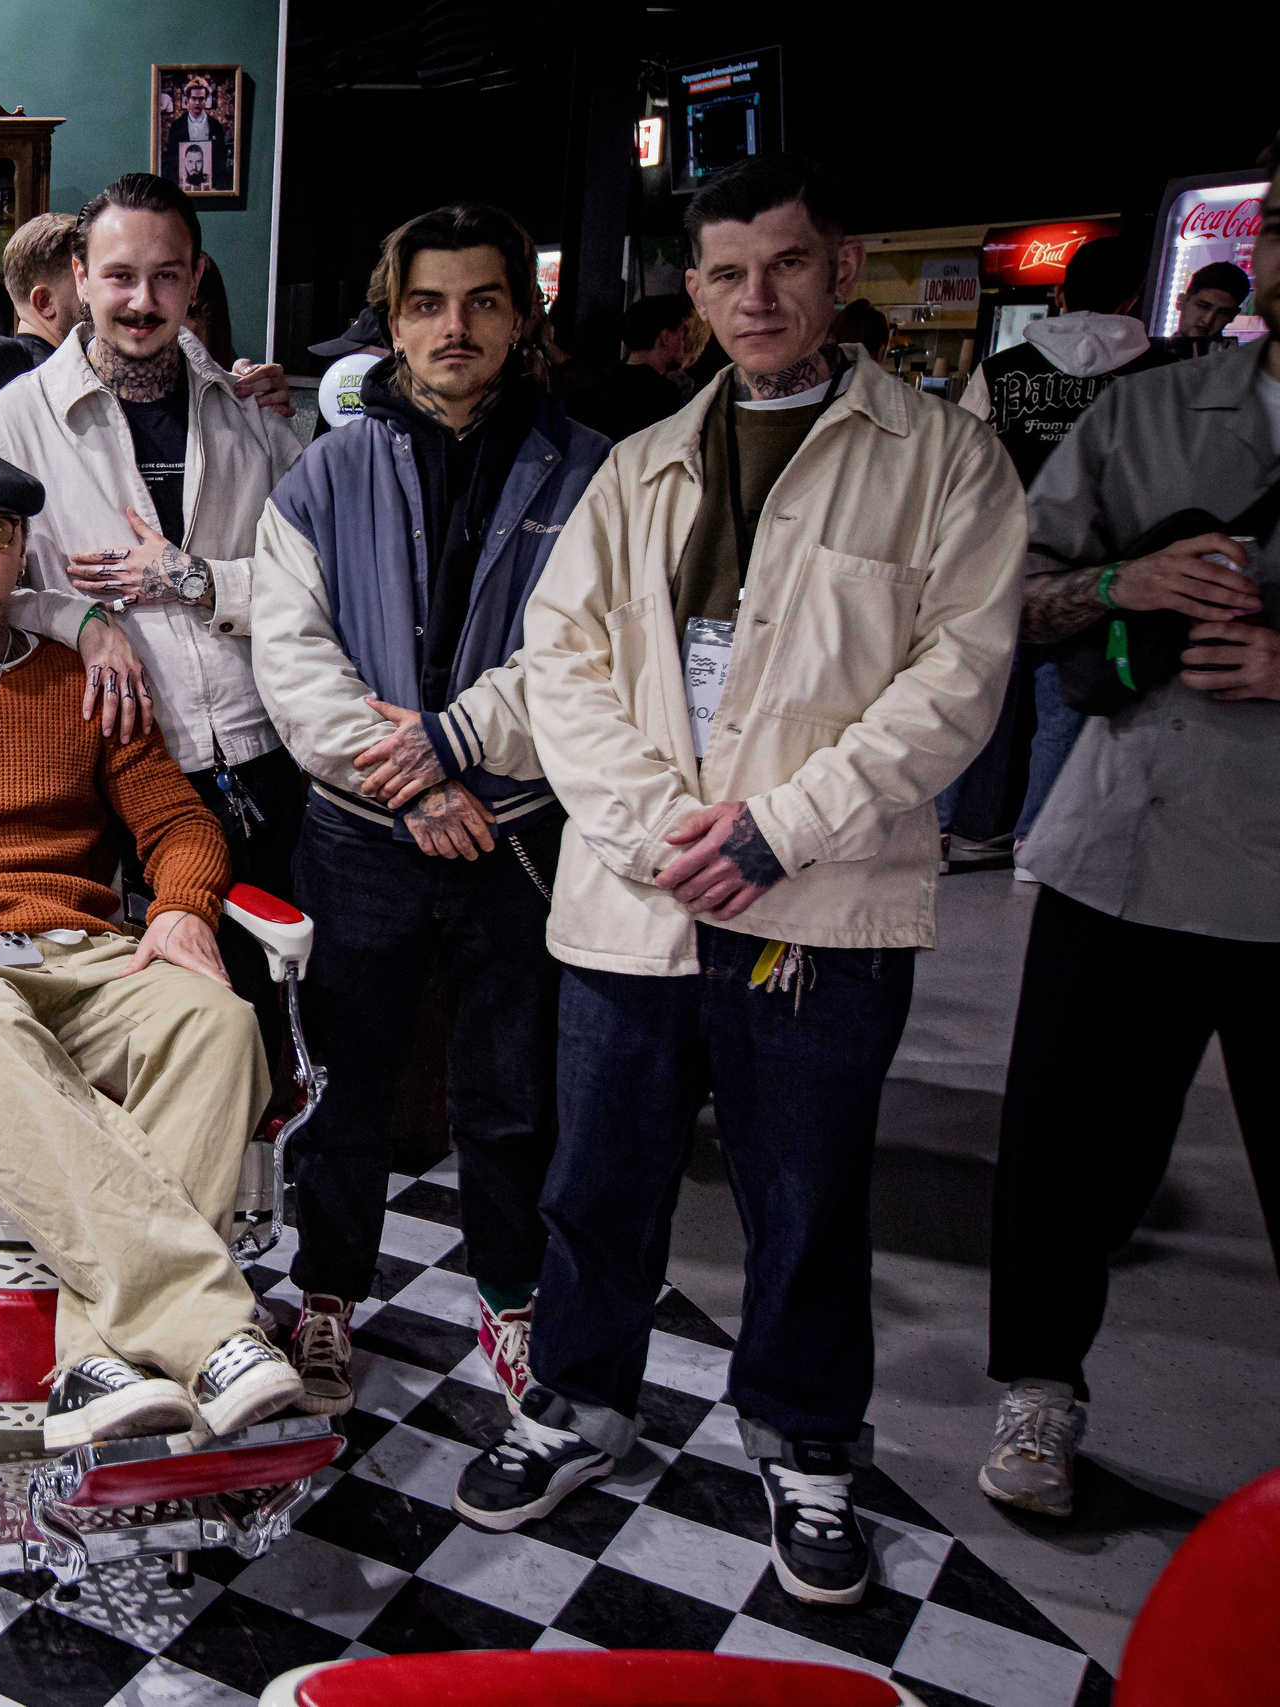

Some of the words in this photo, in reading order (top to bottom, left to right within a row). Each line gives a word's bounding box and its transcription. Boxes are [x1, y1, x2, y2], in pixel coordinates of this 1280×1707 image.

[1031, 242, 1069, 264] Bud
[943, 264, 960, 276] GIN
[340, 374, 365, 388] REUZ
[1025, 419, 1063, 433] From
